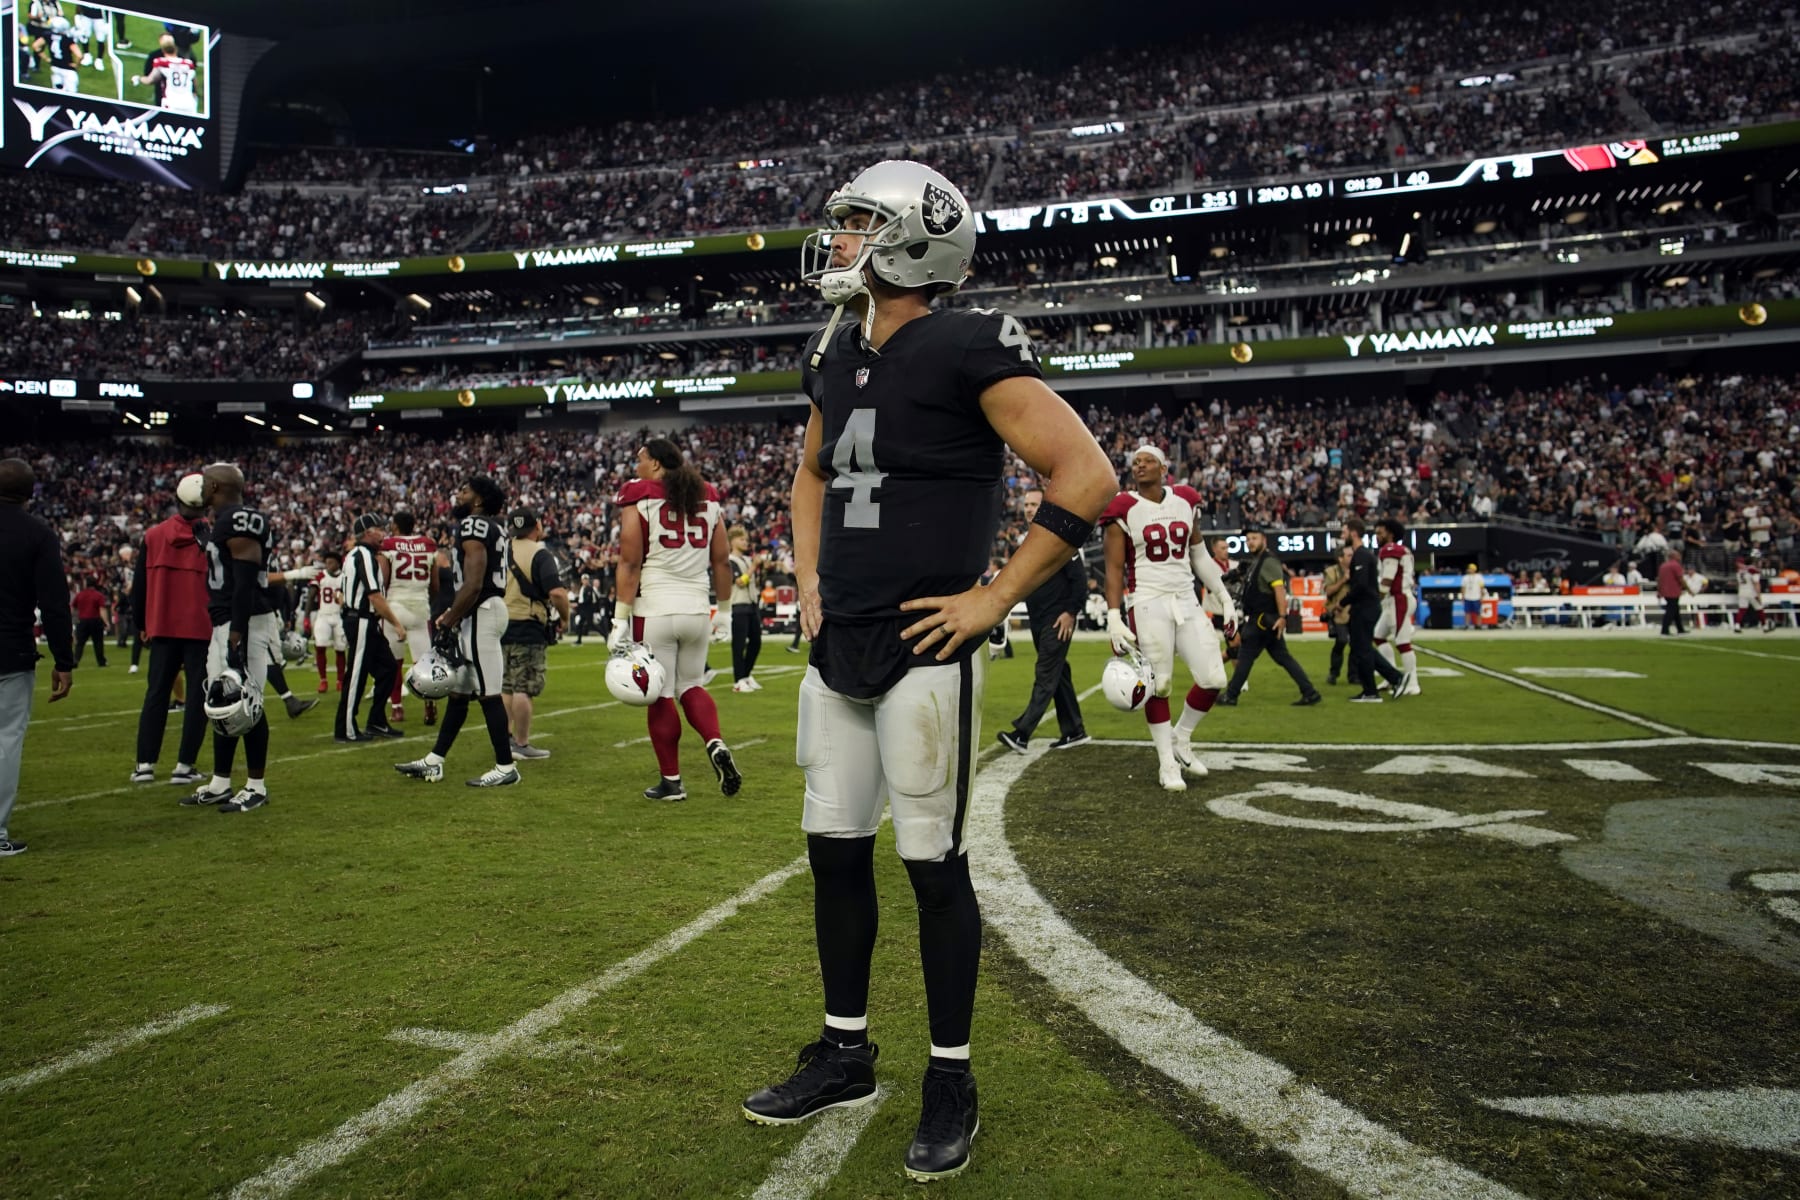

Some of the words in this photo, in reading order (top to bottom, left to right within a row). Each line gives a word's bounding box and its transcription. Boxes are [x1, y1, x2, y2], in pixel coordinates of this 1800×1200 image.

[172, 71, 189, 87] 87
[1150, 197, 1175, 213] OT
[1201, 190, 1237, 208] 3:51
[1257, 186, 1289, 204] 2ND
[1290, 184, 1303, 200] &
[1304, 182, 1323, 198] 10
[1344, 178, 1366, 192] ON
[1406, 171, 1431, 186] 40
[998, 313, 1034, 362] 4
[15, 380, 47, 394] DEN
[99, 382, 144, 397] FINAL
[831, 408, 889, 529] 4
[232, 511, 264, 535] 30
[460, 518, 489, 539] 39
[659, 500, 708, 549] 95
[1142, 520, 1190, 563] 89
[1277, 535, 1315, 552] 3:51
[1428, 532, 1452, 547] 40
[396, 552, 429, 581] 25
